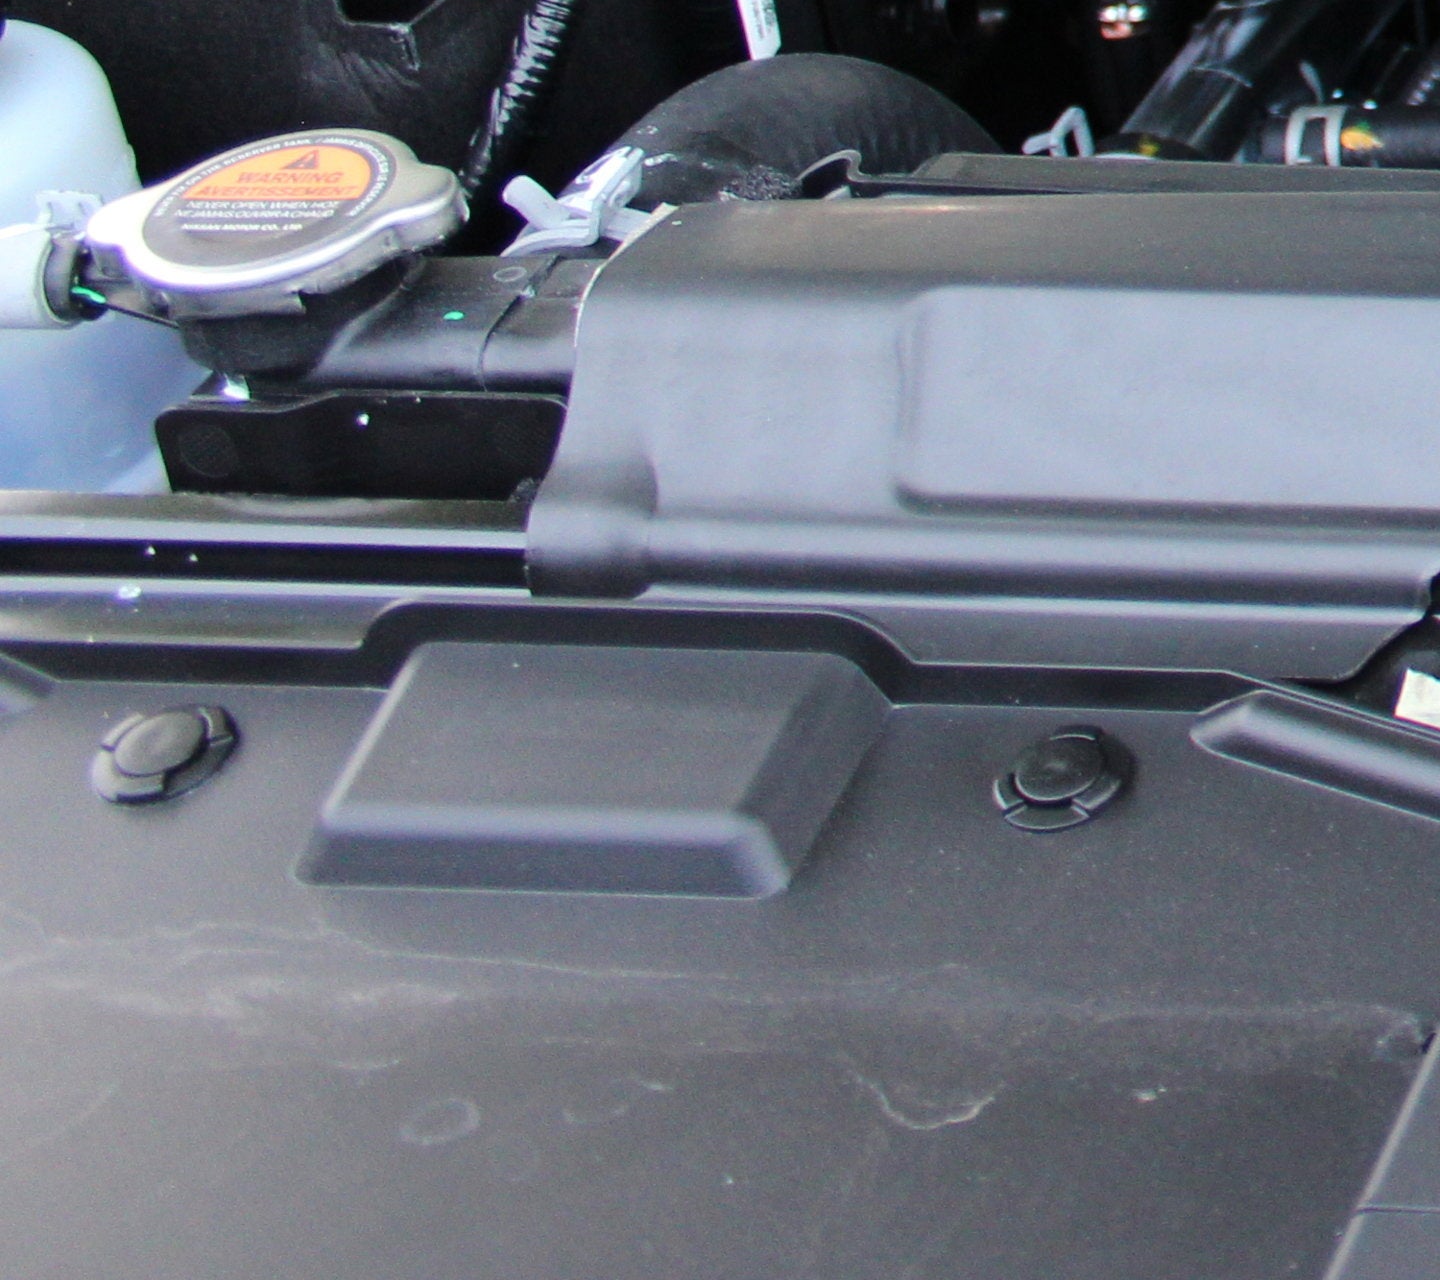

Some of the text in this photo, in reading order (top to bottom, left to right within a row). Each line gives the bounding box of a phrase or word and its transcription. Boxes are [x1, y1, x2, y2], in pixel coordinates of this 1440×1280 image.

[237, 171, 344, 184] WARNING
[193, 185, 359, 196] AVERTISSEMENT
[186, 200, 230, 209] NEVER
[231, 200, 268, 209] OPEN
[270, 200, 310, 209] WHEN
[181, 223, 220, 231] NISSAN
[221, 223, 259, 231] MOTOR
